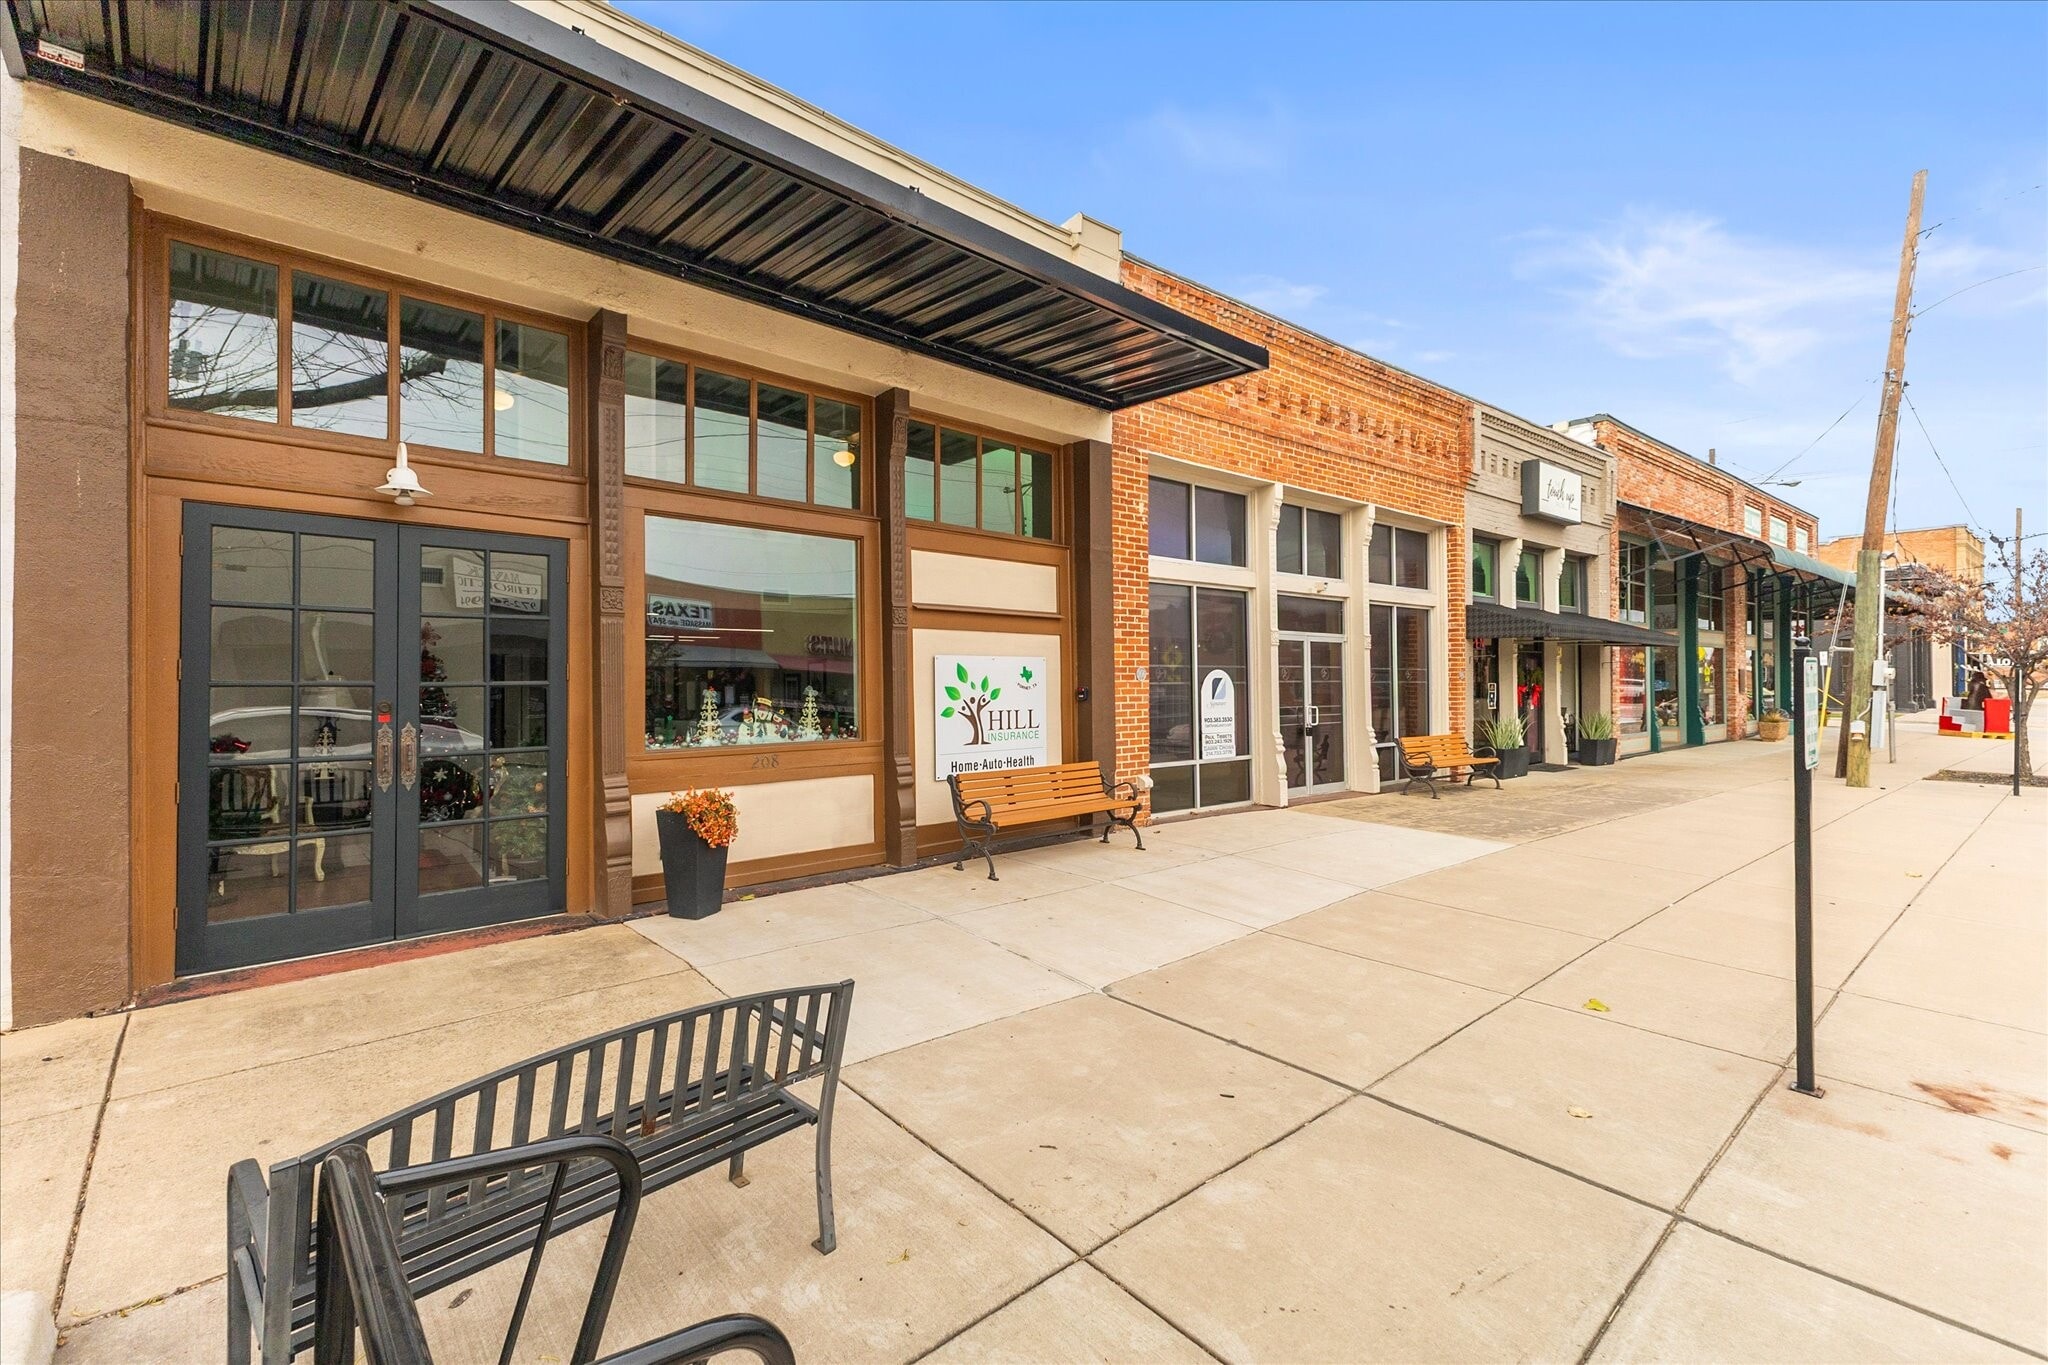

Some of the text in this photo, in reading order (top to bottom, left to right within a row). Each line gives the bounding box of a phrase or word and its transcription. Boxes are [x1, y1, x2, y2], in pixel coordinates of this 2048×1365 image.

[988, 709, 1040, 731] HILL
[987, 730, 1040, 742] INSURANCE
[751, 754, 780, 769] 208
